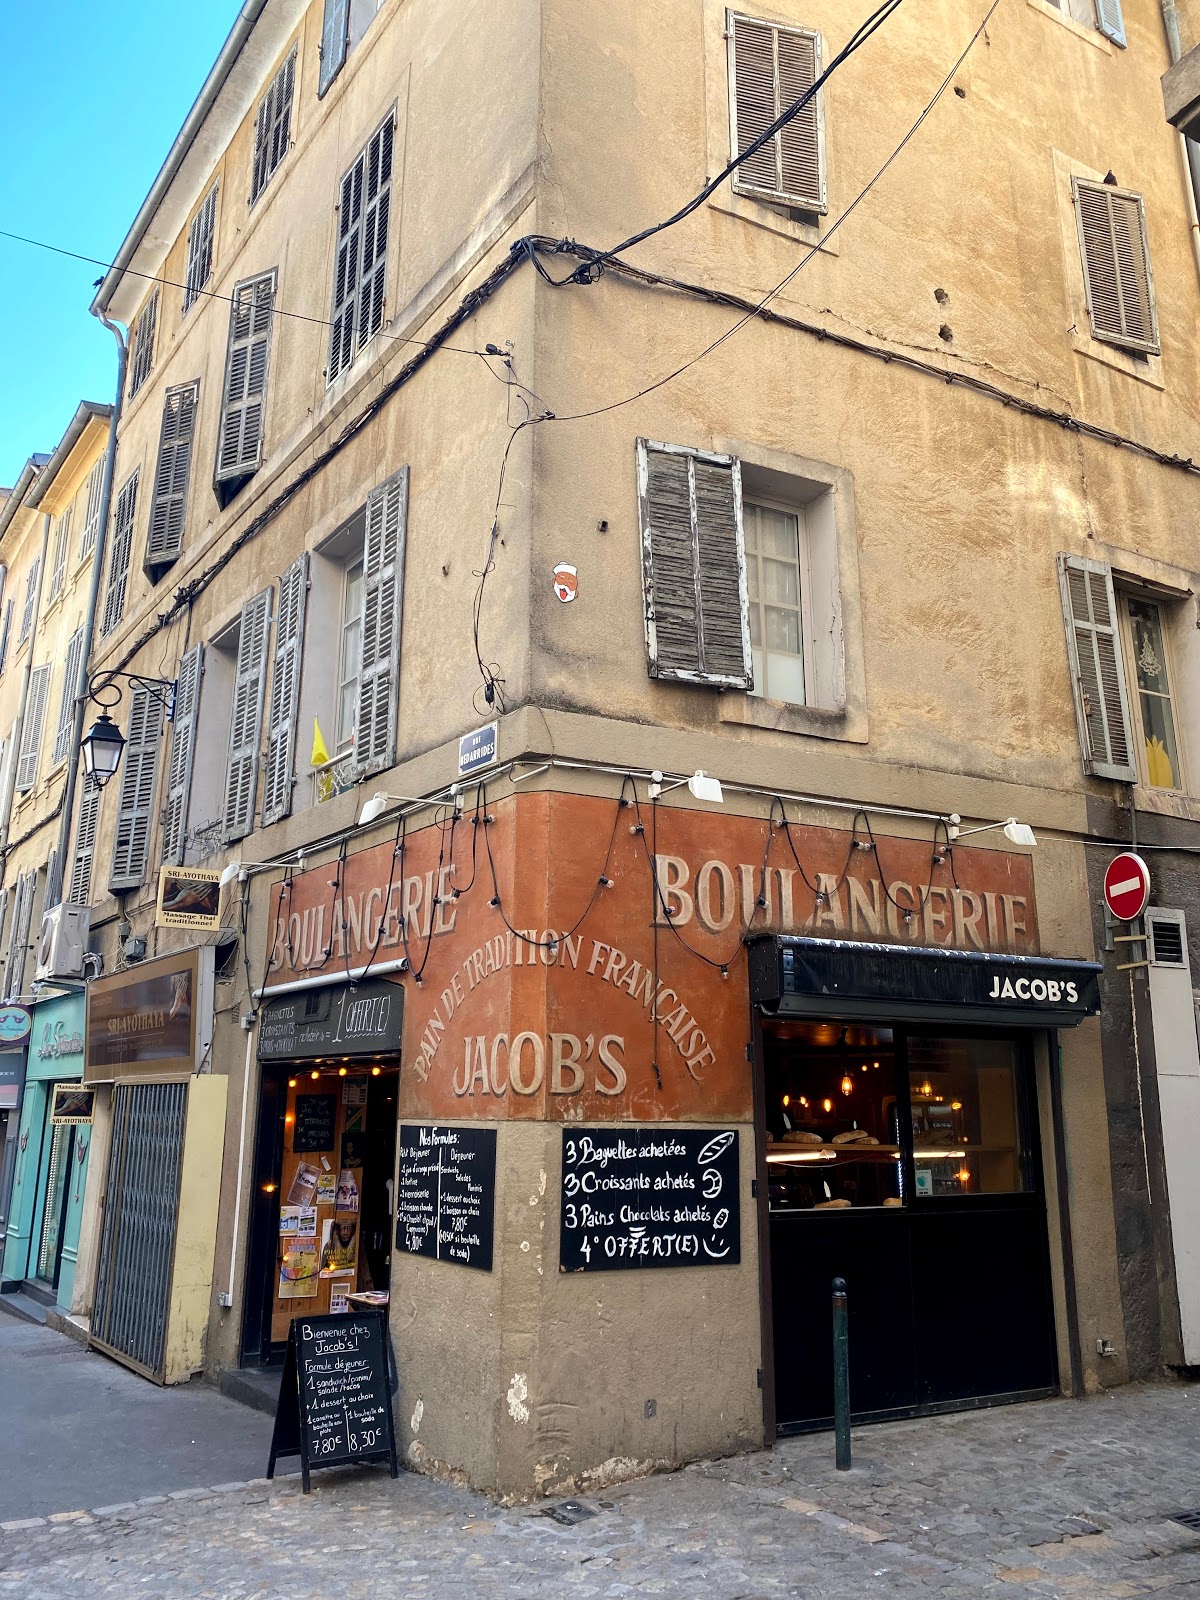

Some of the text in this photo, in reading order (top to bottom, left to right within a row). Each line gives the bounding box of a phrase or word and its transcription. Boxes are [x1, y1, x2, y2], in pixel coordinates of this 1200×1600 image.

[167, 870, 219, 881] SRI-AYOTHAYA
[651, 854, 1029, 953] BOULANGERIE
[163, 911, 197, 920] Massage
[165, 918, 213, 927] traditionnel
[268, 864, 457, 973] BOULANGERIE
[989, 975, 1079, 1003] JACOB'S
[413, 928, 717, 1084] PAIN DE TRADITION FRANÇAISE
[107, 1009, 165, 1036] SRI-AYOTHAYA
[452, 1031, 627, 1096] JACOB'S
[420, 1127, 431, 1146] Nos
[451, 1148, 476, 1163] Déjeuner
[565, 1136, 687, 1169] 3 Baguettes achetées
[564, 1171, 696, 1197] 3 Croissants achetés
[565, 1203, 711, 1228] 3 Pains Chocolats achetés
[604, 1233, 699, 1258] OFFERT(E)
[302, 1323, 371, 1340] Bienvenue chez
[305, 1357, 367, 1373] Formule déjeuner
[306, 1375, 316, 1390] 1
[320, 1395, 347, 1408] dessert
[307, 1415, 312, 1425] 1
[360, 1416, 375, 1424] soda
[312, 1435, 342, 1456] 7,80€
[350, 1427, 382, 1452] 8,30€
